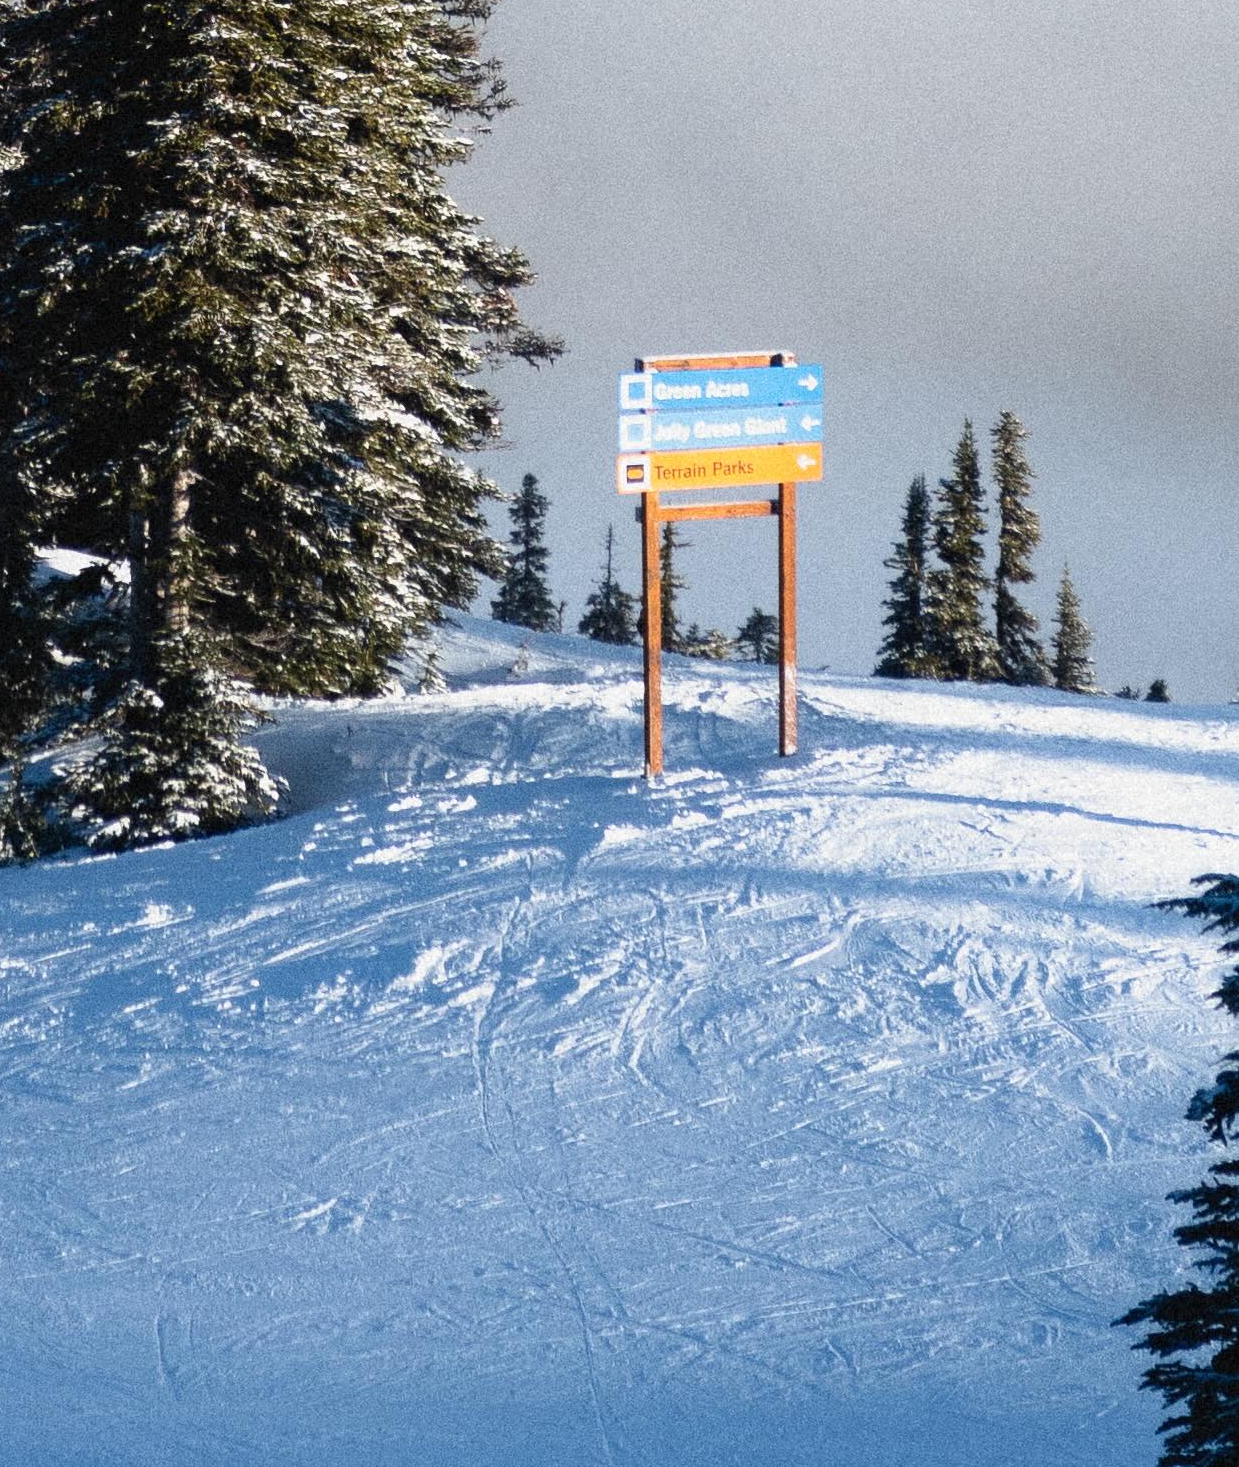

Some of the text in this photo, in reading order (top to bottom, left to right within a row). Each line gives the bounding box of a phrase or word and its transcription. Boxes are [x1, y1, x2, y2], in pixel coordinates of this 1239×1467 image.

[654, 380, 749, 400] Green Acres
[655, 417, 787, 442] Jolly Green Giant
[654, 460, 754, 480] Terrain Parks
